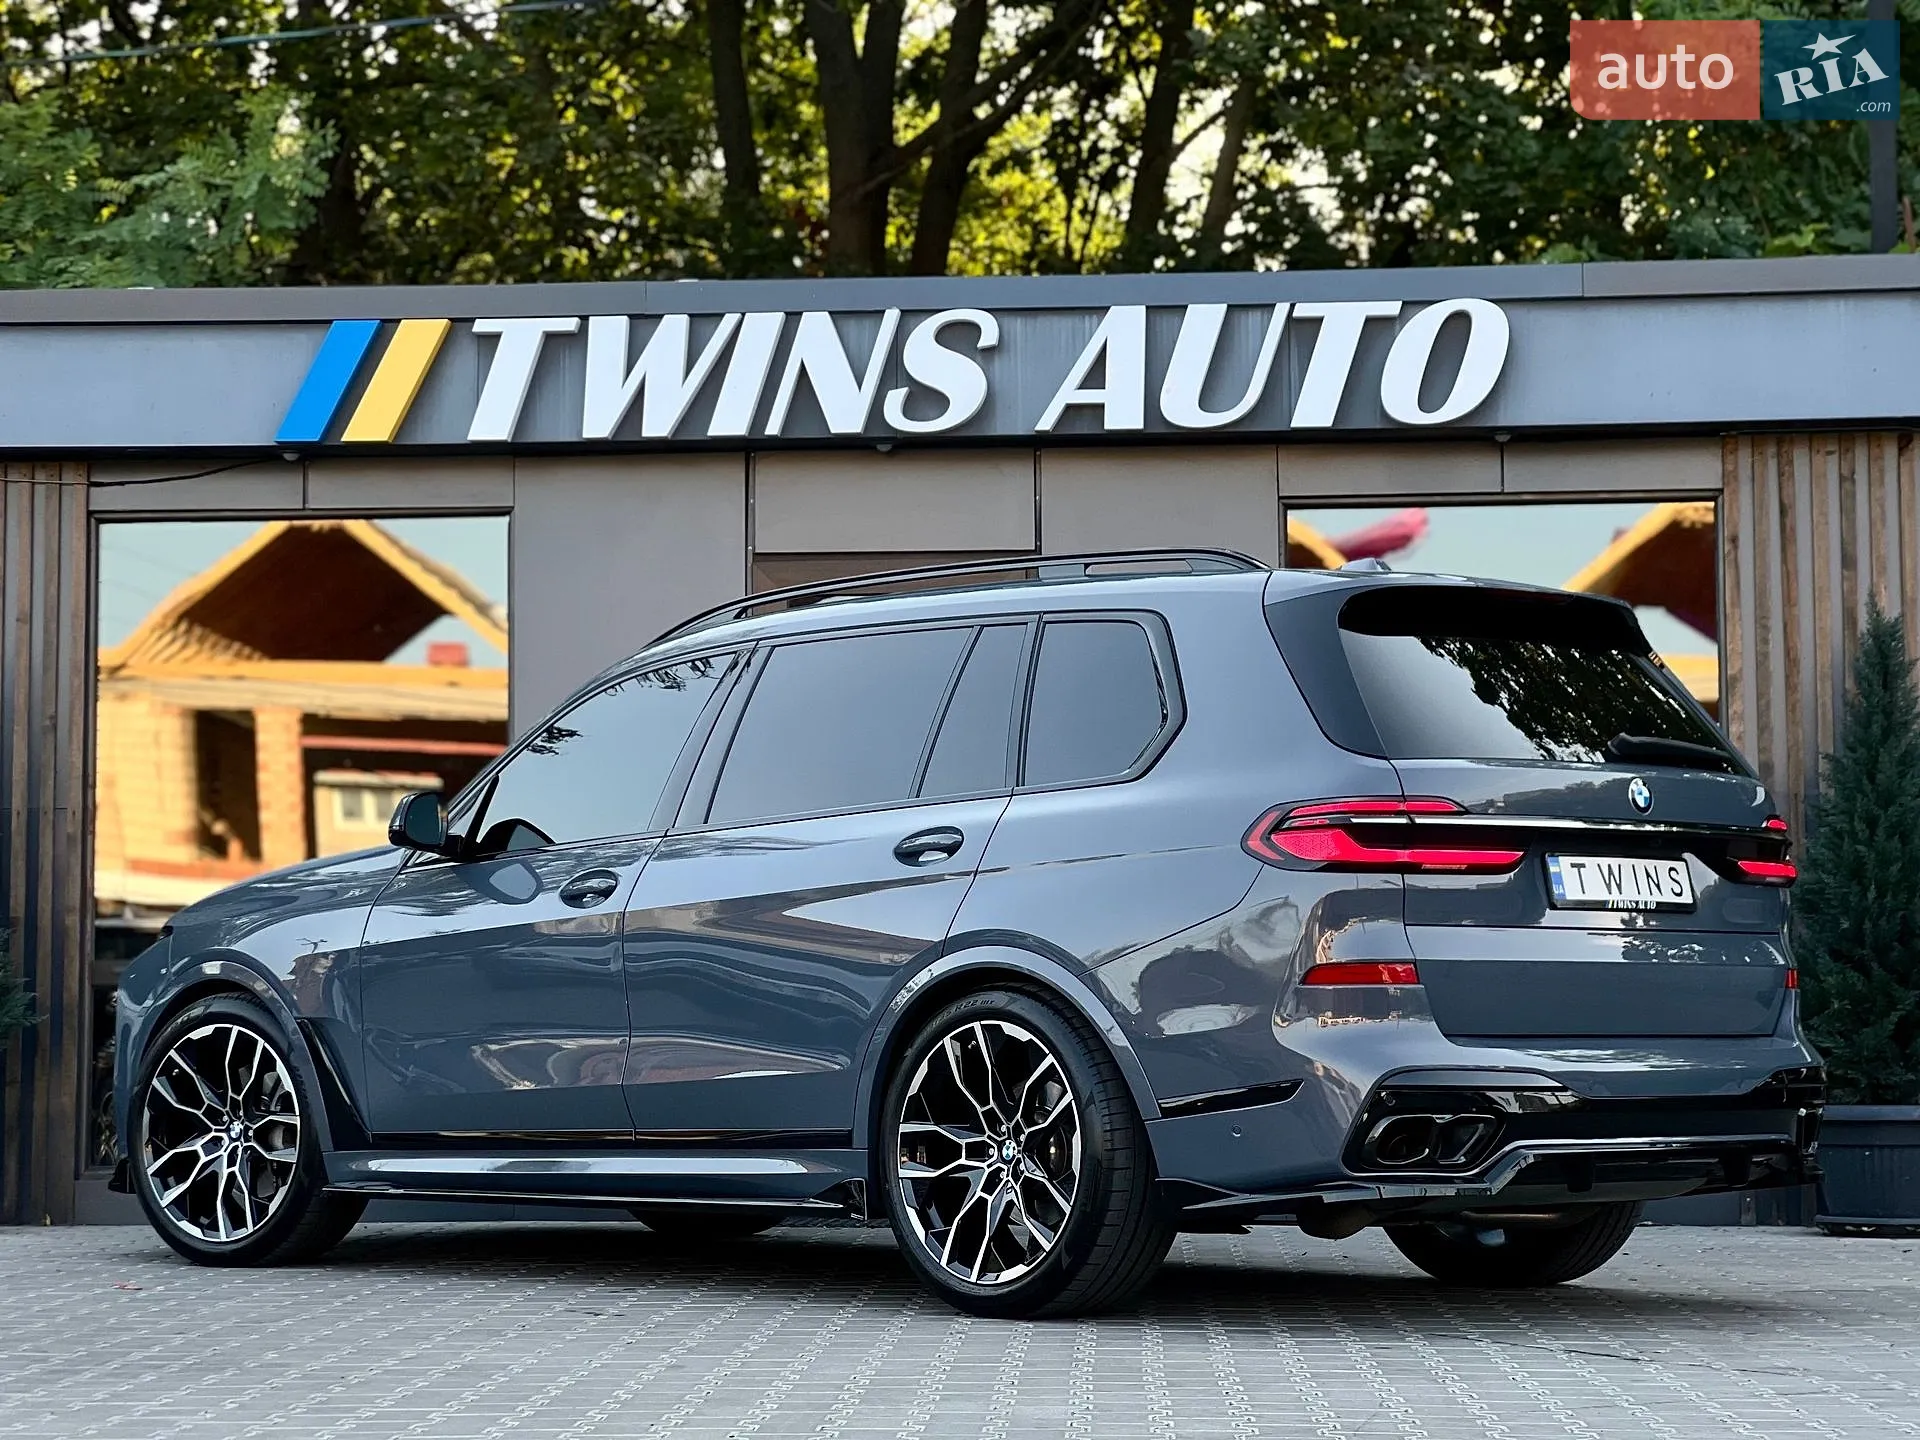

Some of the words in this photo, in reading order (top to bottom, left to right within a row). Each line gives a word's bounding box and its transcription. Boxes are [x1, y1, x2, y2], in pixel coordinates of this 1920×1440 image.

[467, 307, 1000, 442] TWINS
[1034, 298, 1510, 432] AUTO
[1570, 863, 1683, 897] TWINS
